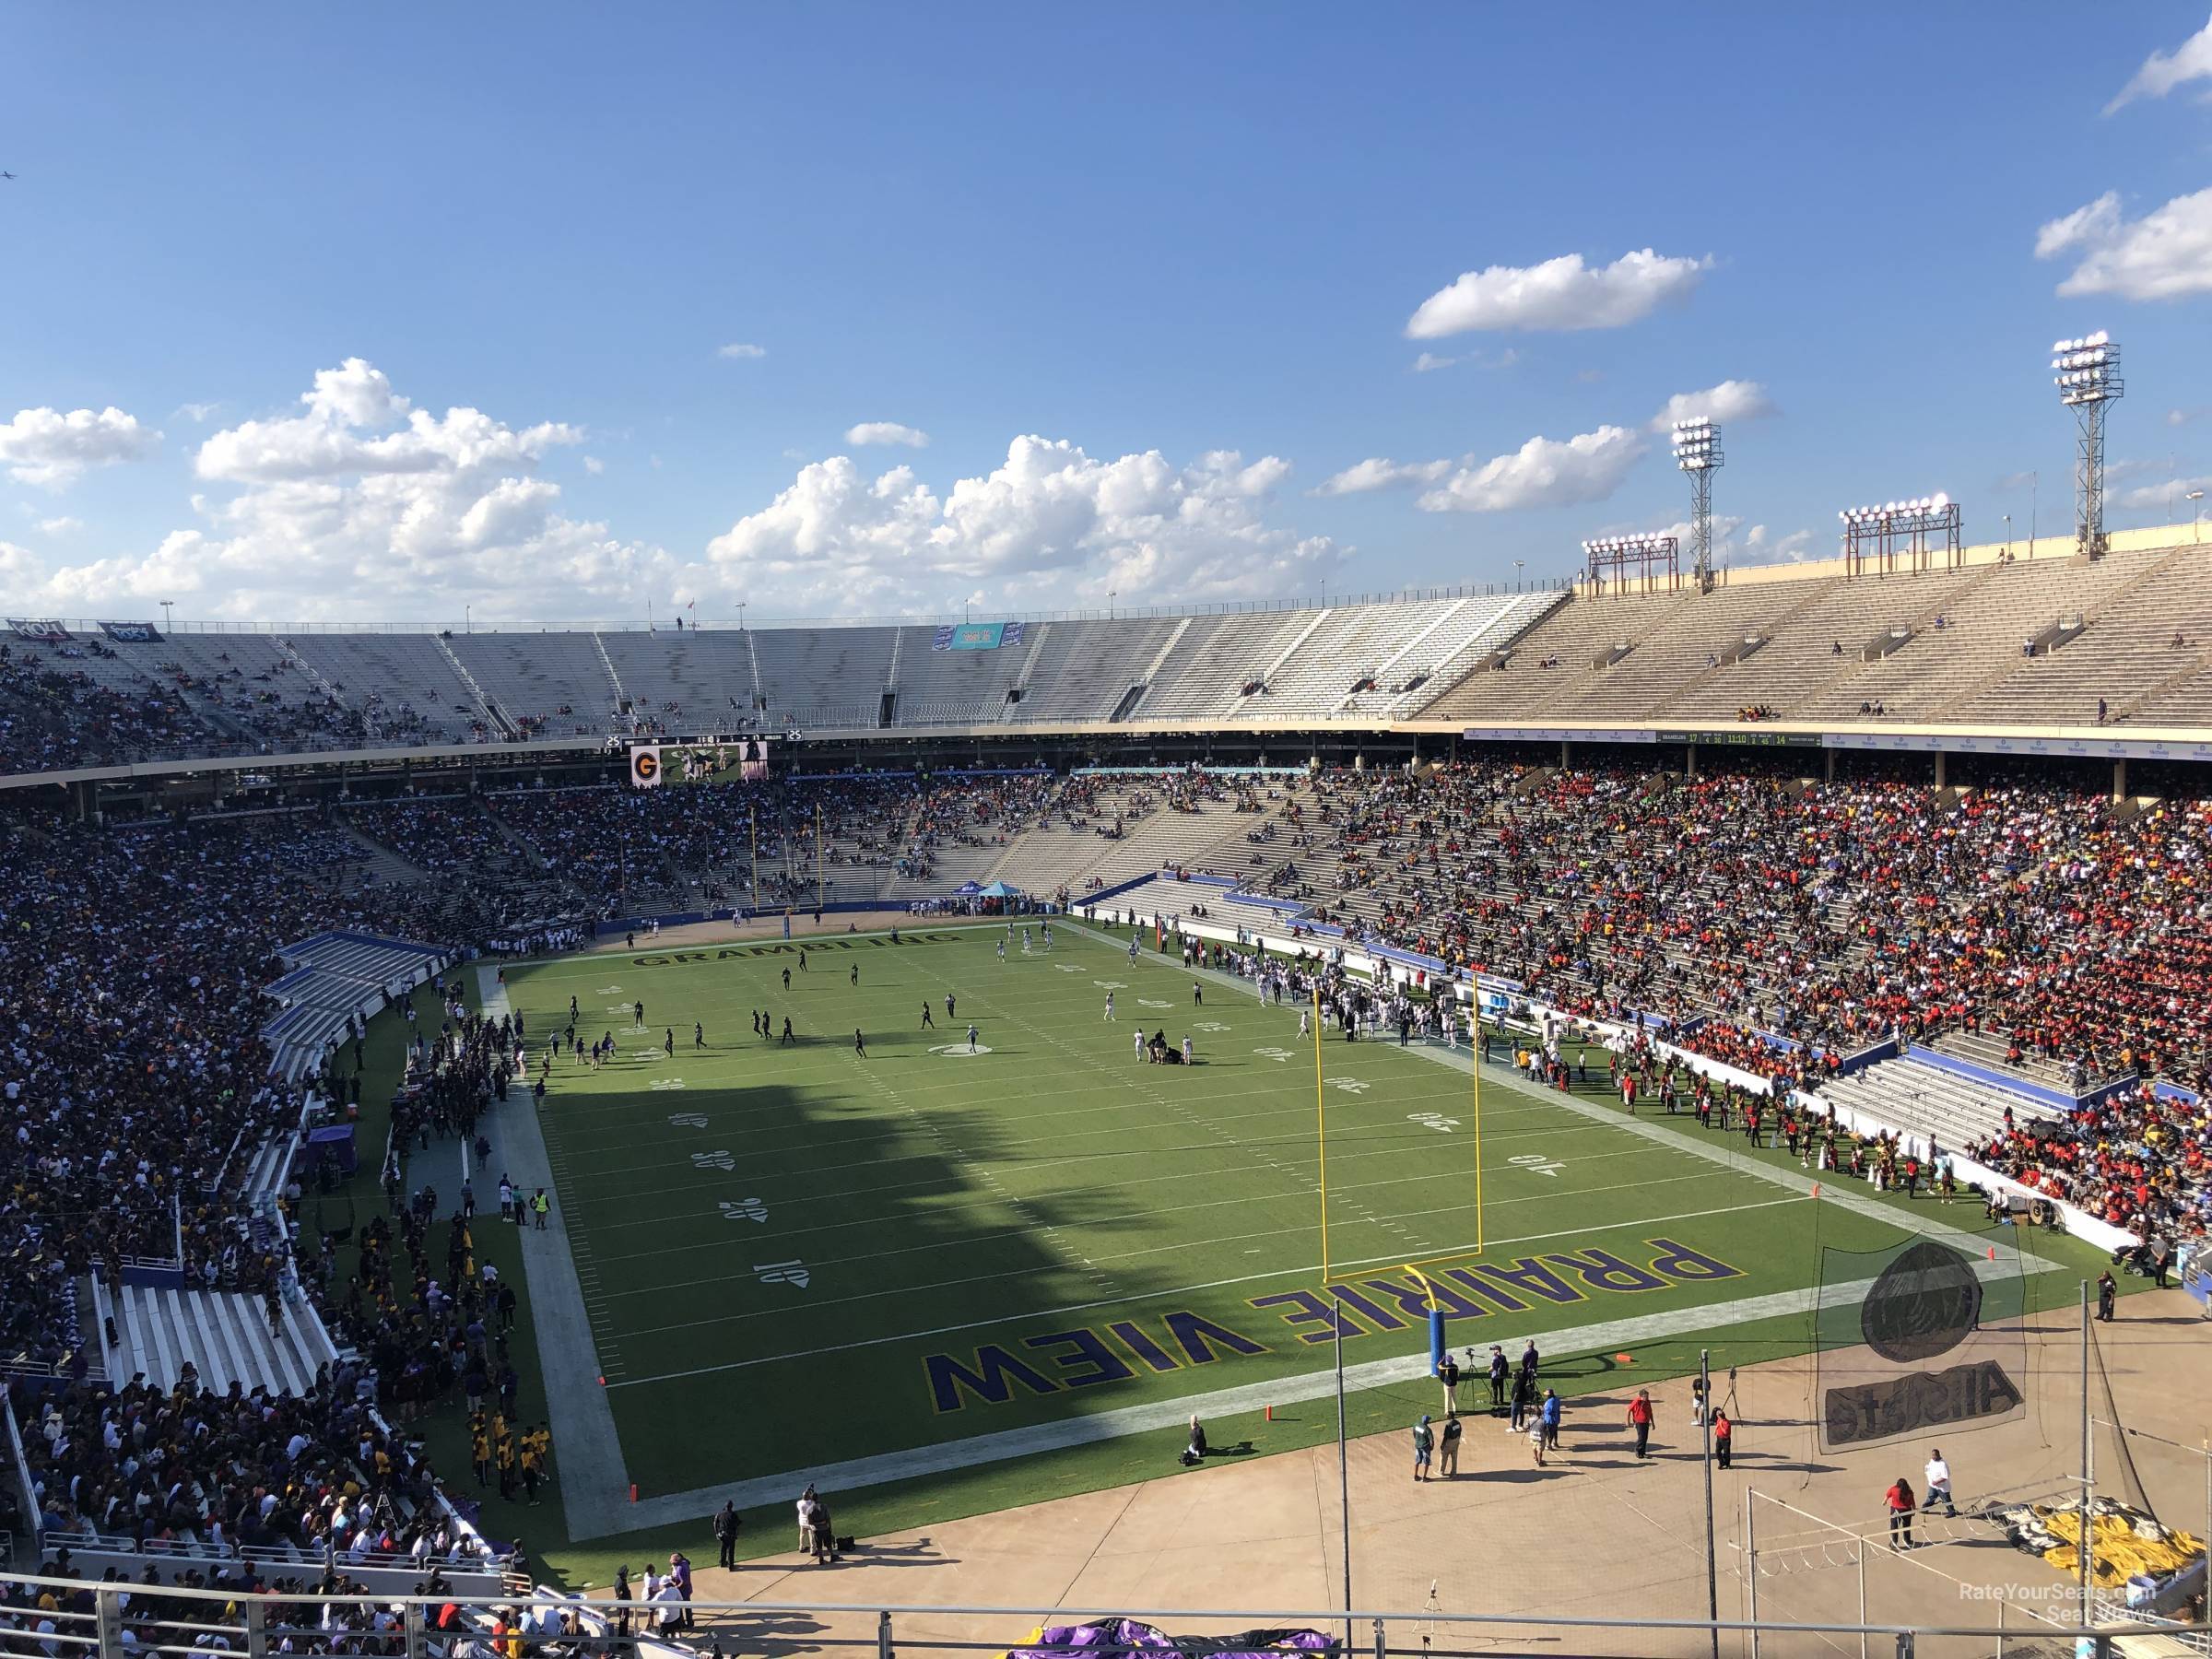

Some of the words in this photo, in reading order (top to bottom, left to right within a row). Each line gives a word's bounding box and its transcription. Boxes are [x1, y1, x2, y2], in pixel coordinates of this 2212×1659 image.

[607, 736, 620, 746] 25
[790, 730, 801, 739] 25
[1689, 734, 1698, 742] 17
[1777, 735, 1785, 744] 14
[633, 934, 963, 967] GRAMBLING
[1406, 1112, 1462, 1129] 20
[691, 1150, 735, 1168] 30
[1507, 1155, 1567, 1172] 10
[719, 1197, 769, 1218] 20
[753, 1259, 810, 1284] 10
[1244, 1237, 1749, 1346] PRAIRIE
[923, 1310, 1274, 1415] VIEW
